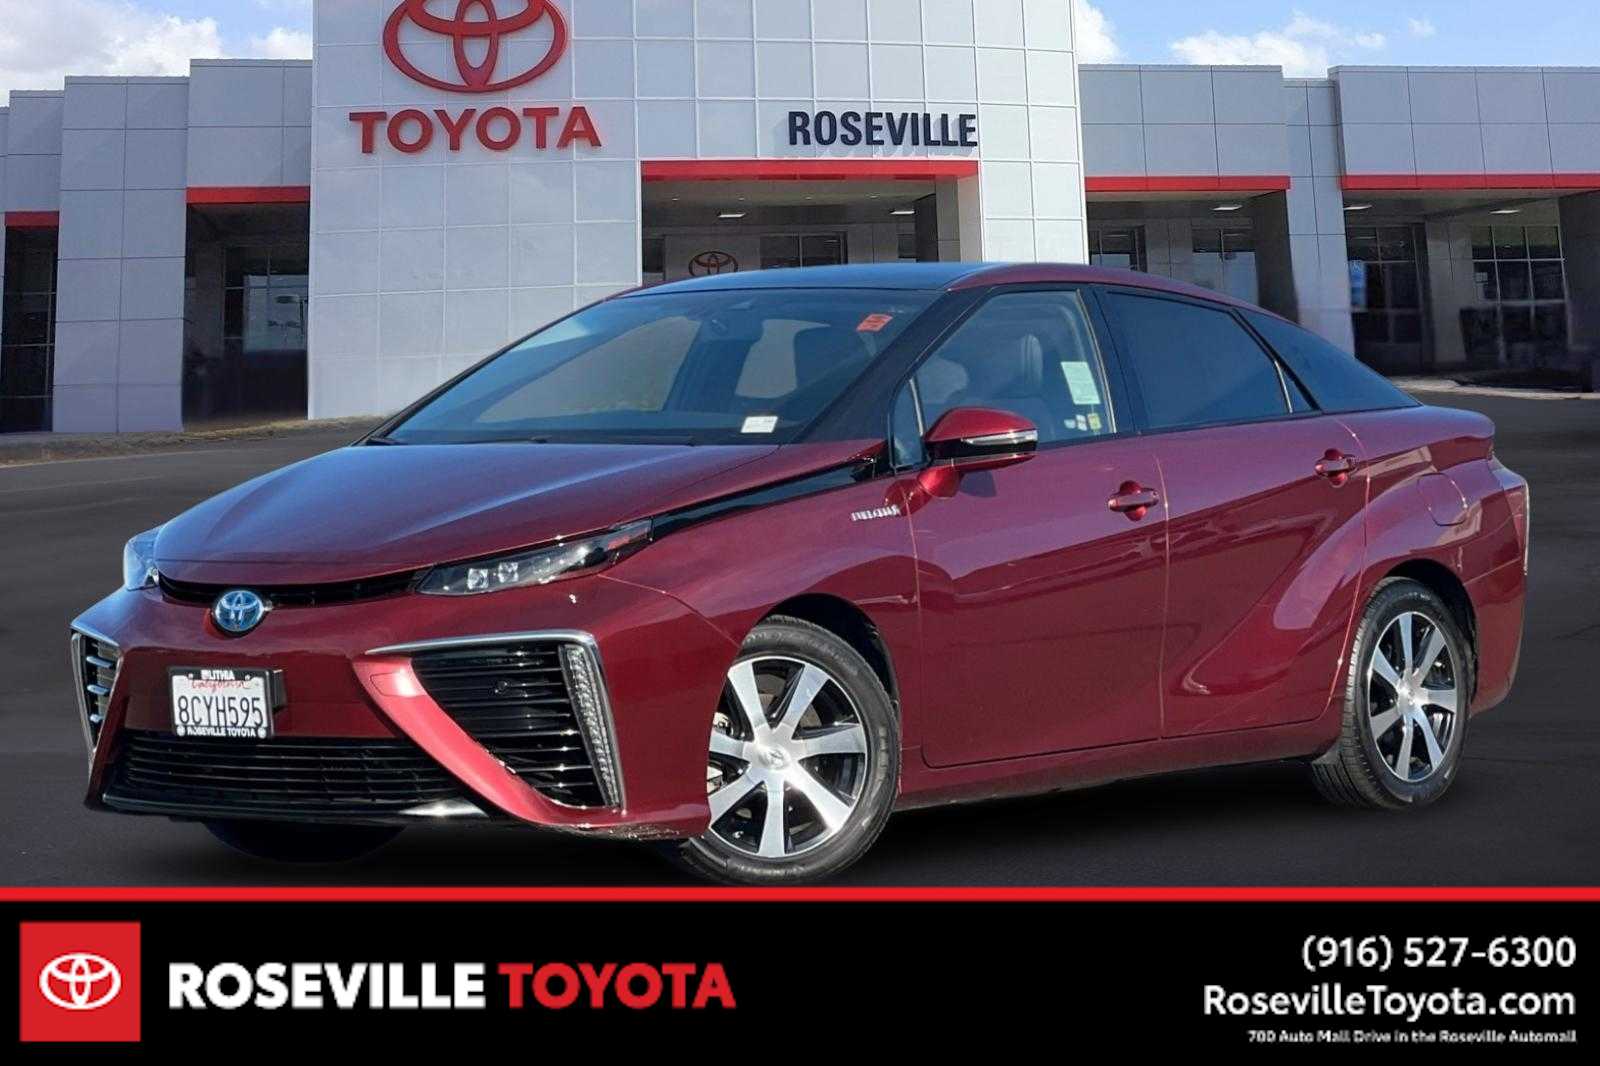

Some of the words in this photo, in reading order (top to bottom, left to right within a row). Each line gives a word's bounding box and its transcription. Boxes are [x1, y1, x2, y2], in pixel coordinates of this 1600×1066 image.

[349, 106, 602, 154] TOYOTA
[788, 110, 979, 147] ROSEVILLE
[177, 695, 265, 727] 8CYH595
[187, 726, 227, 737] ROSEVILLE
[227, 727, 257, 738] TOYOTA
